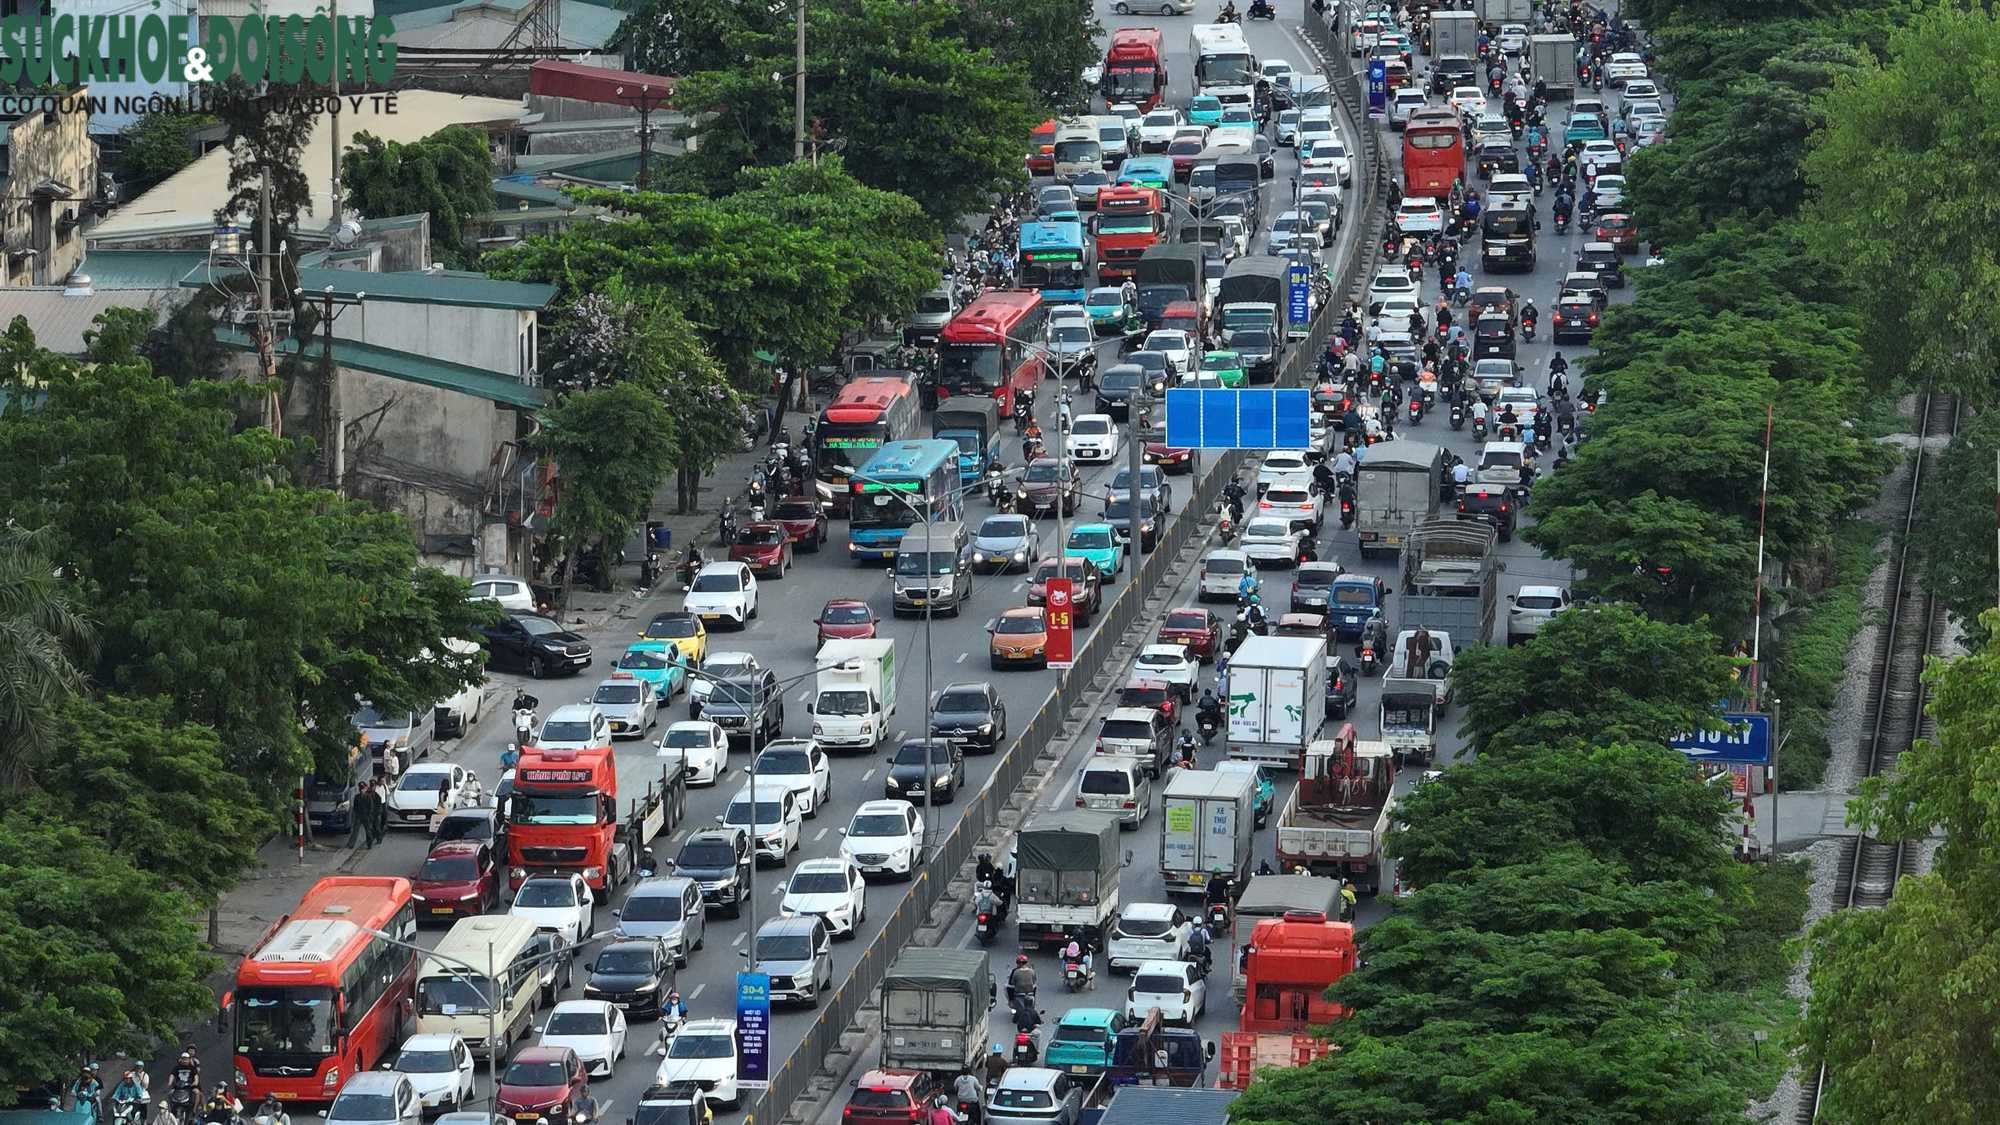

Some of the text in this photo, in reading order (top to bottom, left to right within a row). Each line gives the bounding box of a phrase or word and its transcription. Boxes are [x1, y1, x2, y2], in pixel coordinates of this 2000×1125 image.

[1050, 611, 1069, 626] 1-5
[527, 770, 551, 780] THÀNH
[552, 770, 571, 780] PHÁT
[1216, 807, 1225, 815] XE
[1214, 816, 1228, 824] THƯ
[1212, 825, 1227, 835] BÁO
[742, 985, 765, 995] 30-4
